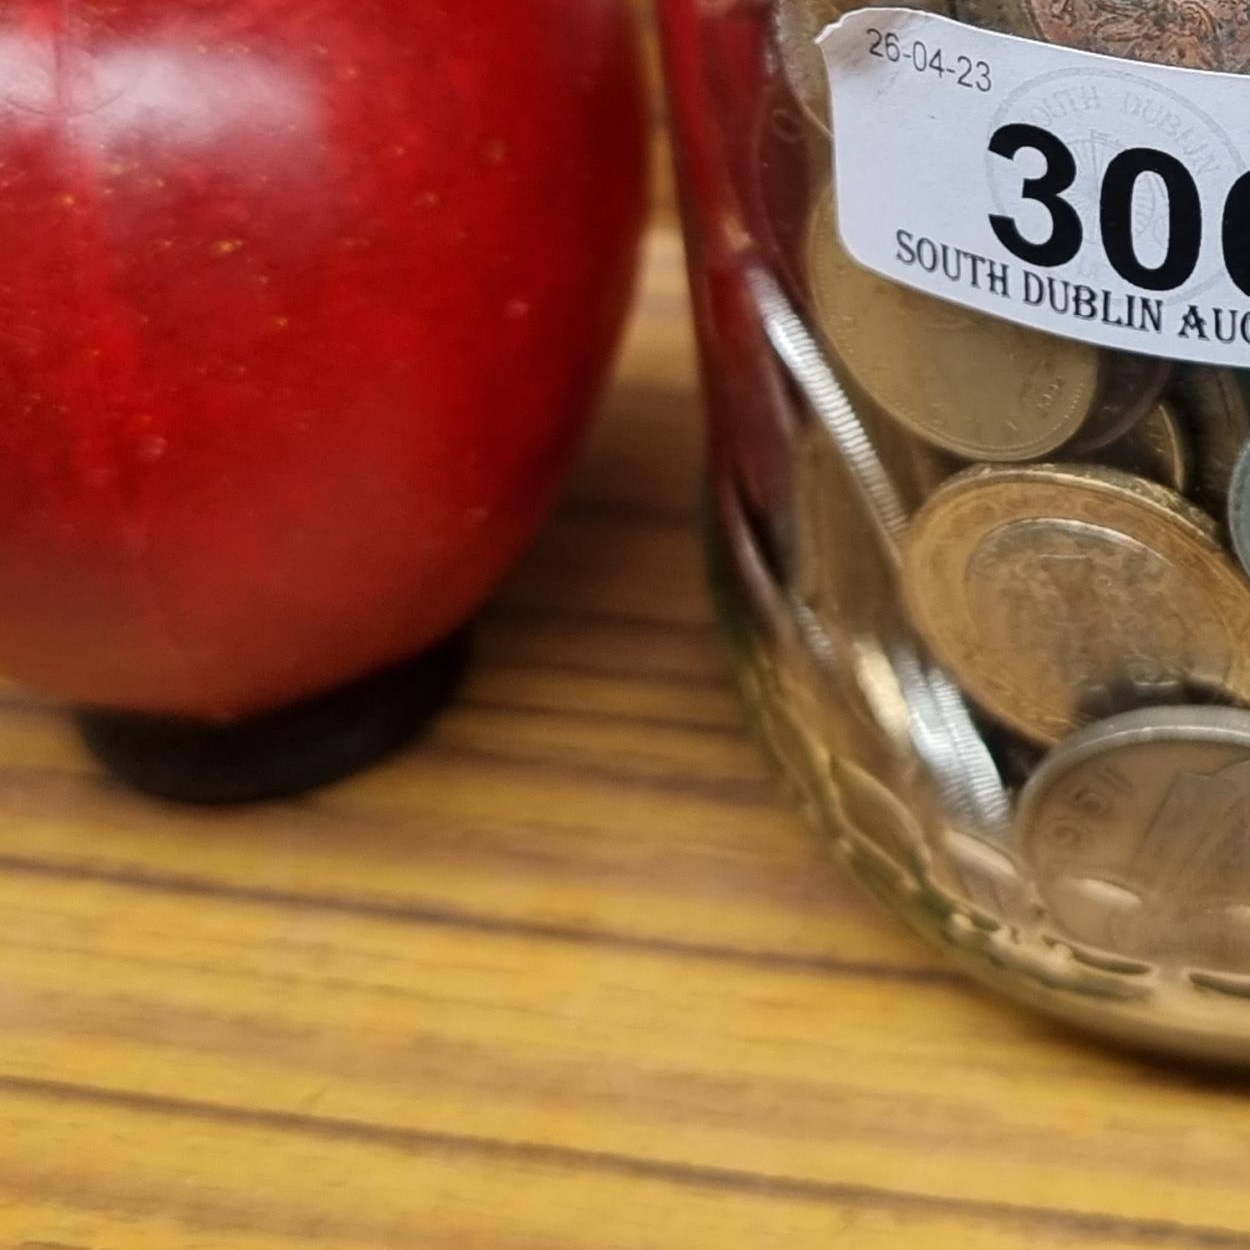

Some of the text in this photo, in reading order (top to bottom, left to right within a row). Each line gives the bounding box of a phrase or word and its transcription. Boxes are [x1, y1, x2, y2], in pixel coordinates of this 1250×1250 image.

[866, 27, 992, 93] 26-04-23
[894, 228, 1011, 300] SOUTH
[1022, 269, 1165, 334] DUBLIN
